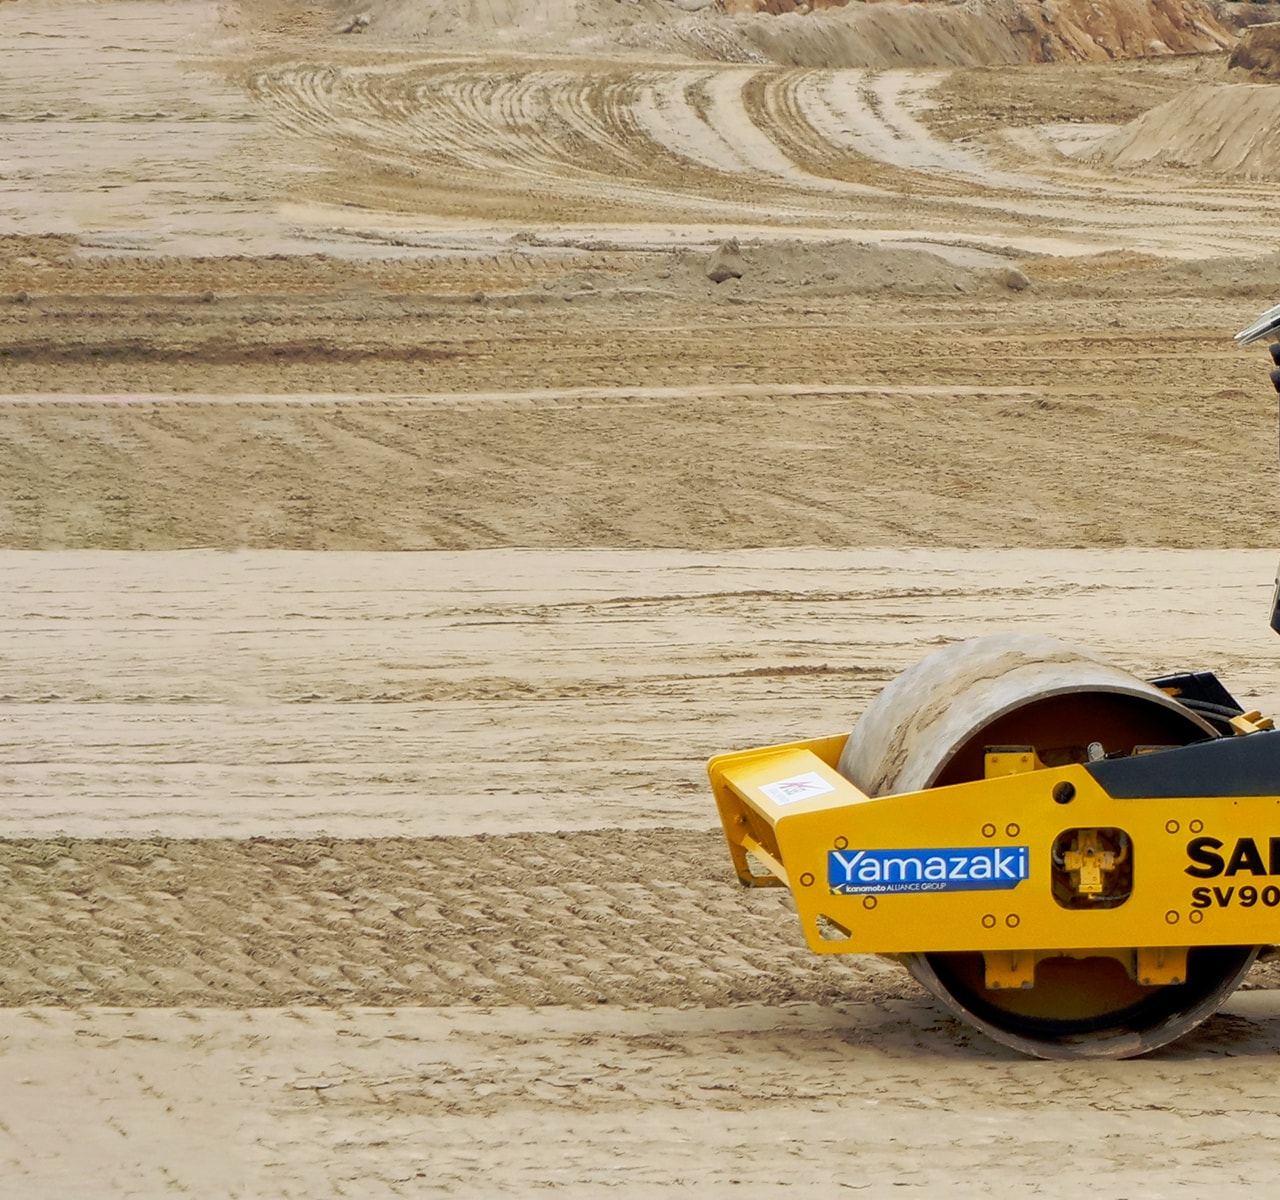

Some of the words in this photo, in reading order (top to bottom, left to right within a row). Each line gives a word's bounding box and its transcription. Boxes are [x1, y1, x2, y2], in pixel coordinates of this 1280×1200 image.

[832, 848, 1025, 882] Yamazaki
[886, 882, 920, 892] ALLIANCE
[921, 882, 947, 890] GROUP
